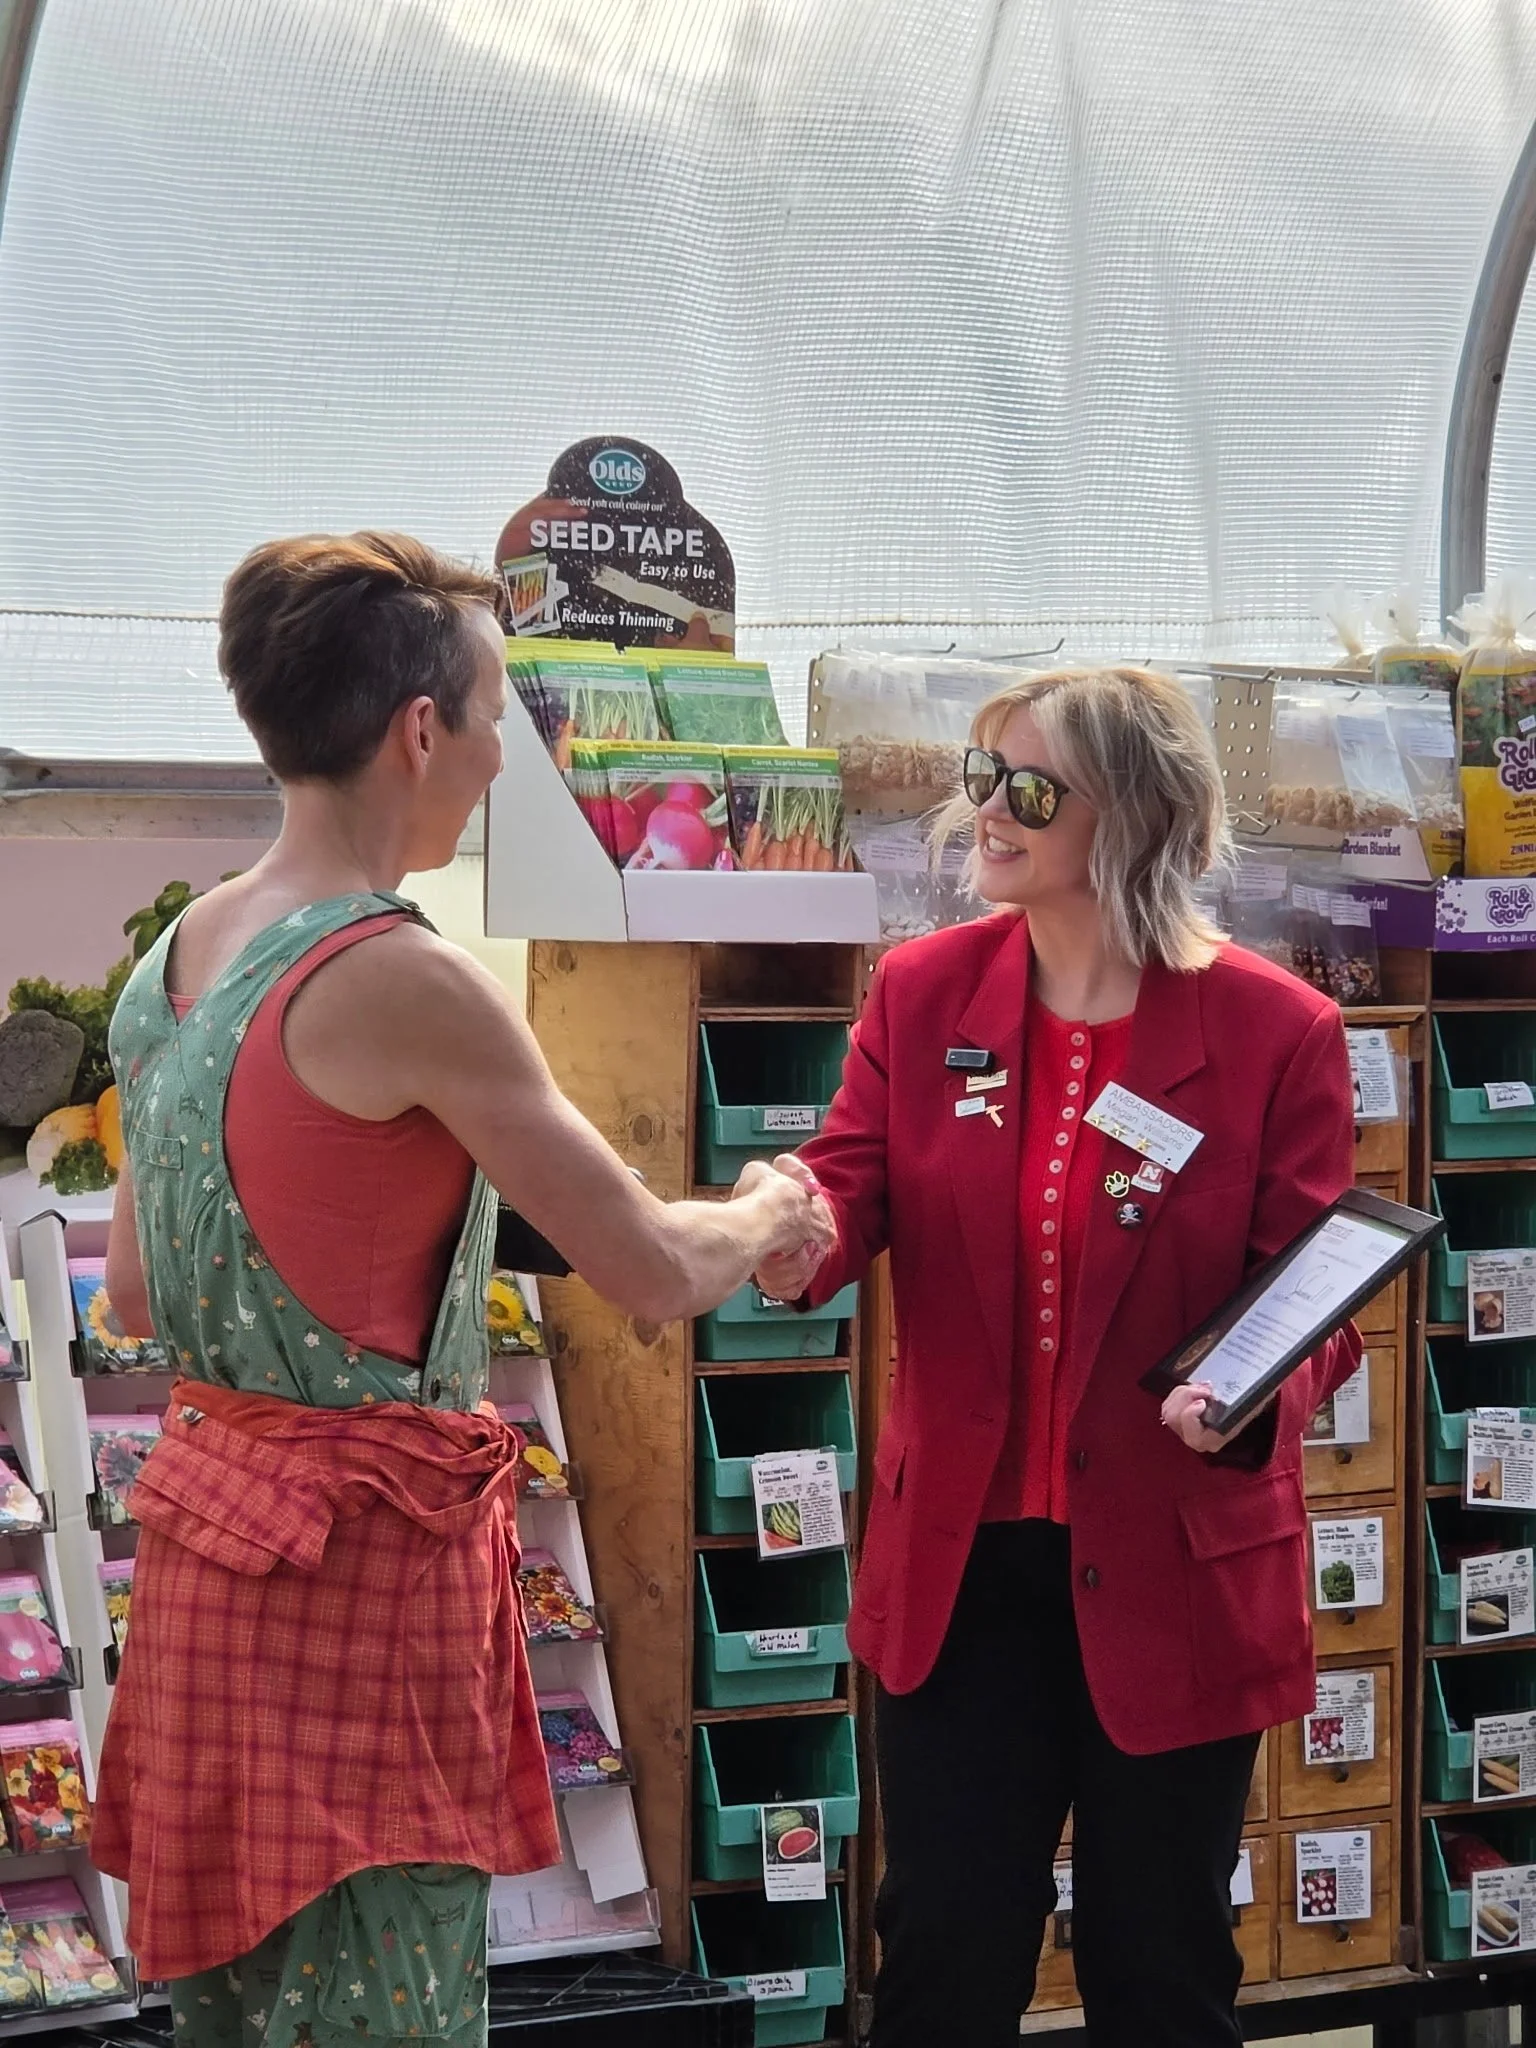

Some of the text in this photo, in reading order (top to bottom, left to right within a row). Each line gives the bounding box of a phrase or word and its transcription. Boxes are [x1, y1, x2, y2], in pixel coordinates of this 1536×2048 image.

[590, 460, 644, 481] Olds
[530, 519, 704, 558] SEED TAPE
[640, 561, 716, 580] Easy to Use
[561, 607, 675, 632] Reduces Thinning
[1369, 842, 1401, 856] Blanket
[1109, 1089, 1196, 1142] AMBASSADORS
